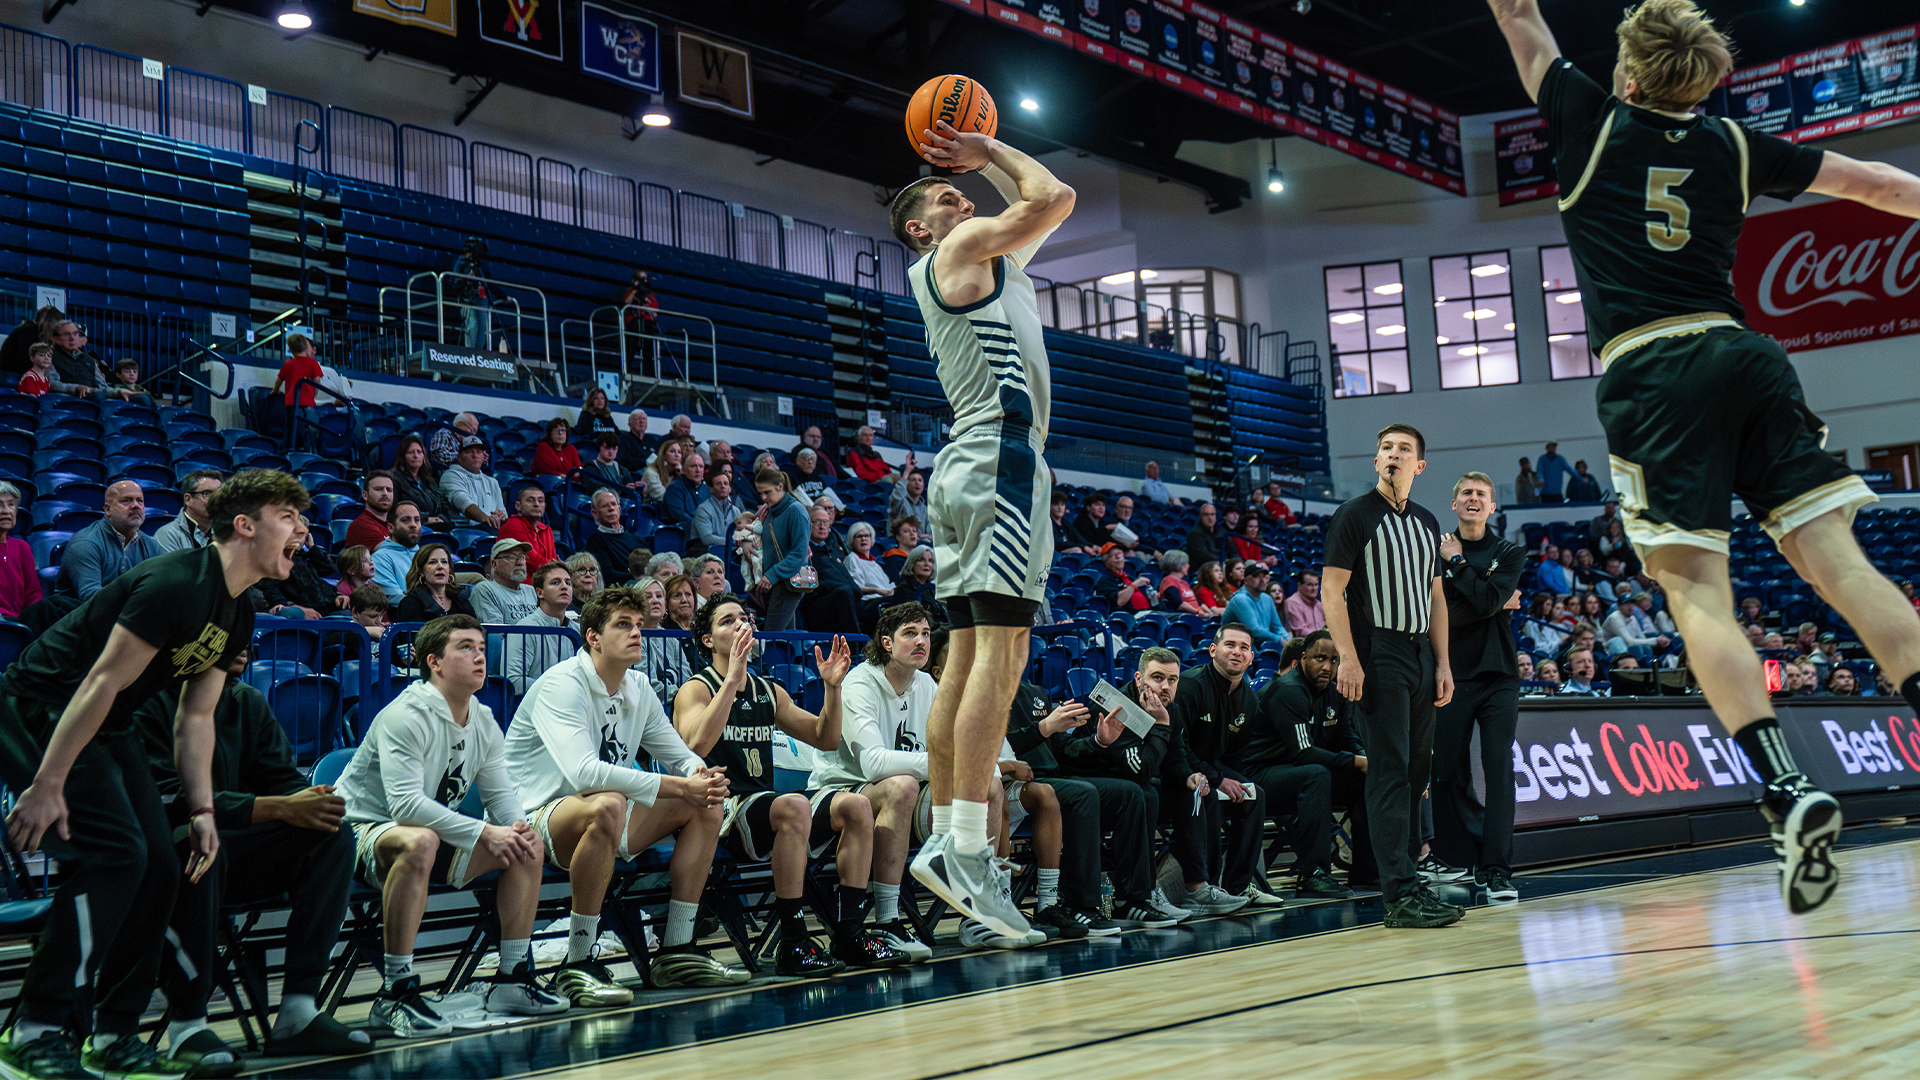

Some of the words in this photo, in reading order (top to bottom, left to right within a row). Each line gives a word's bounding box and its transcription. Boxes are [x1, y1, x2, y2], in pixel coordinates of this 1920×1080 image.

[1645, 166, 1694, 252] 5
[1777, 334, 1811, 350] roud
[1813, 324, 1876, 345] Sponsor
[1879, 319, 1896, 334] of
[429, 348, 477, 367] Reserved
[477, 355, 515, 374] Seating
[742, 748, 763, 778] 10
[1600, 722, 1701, 797] Coke
[1820, 718, 1905, 775] Best
